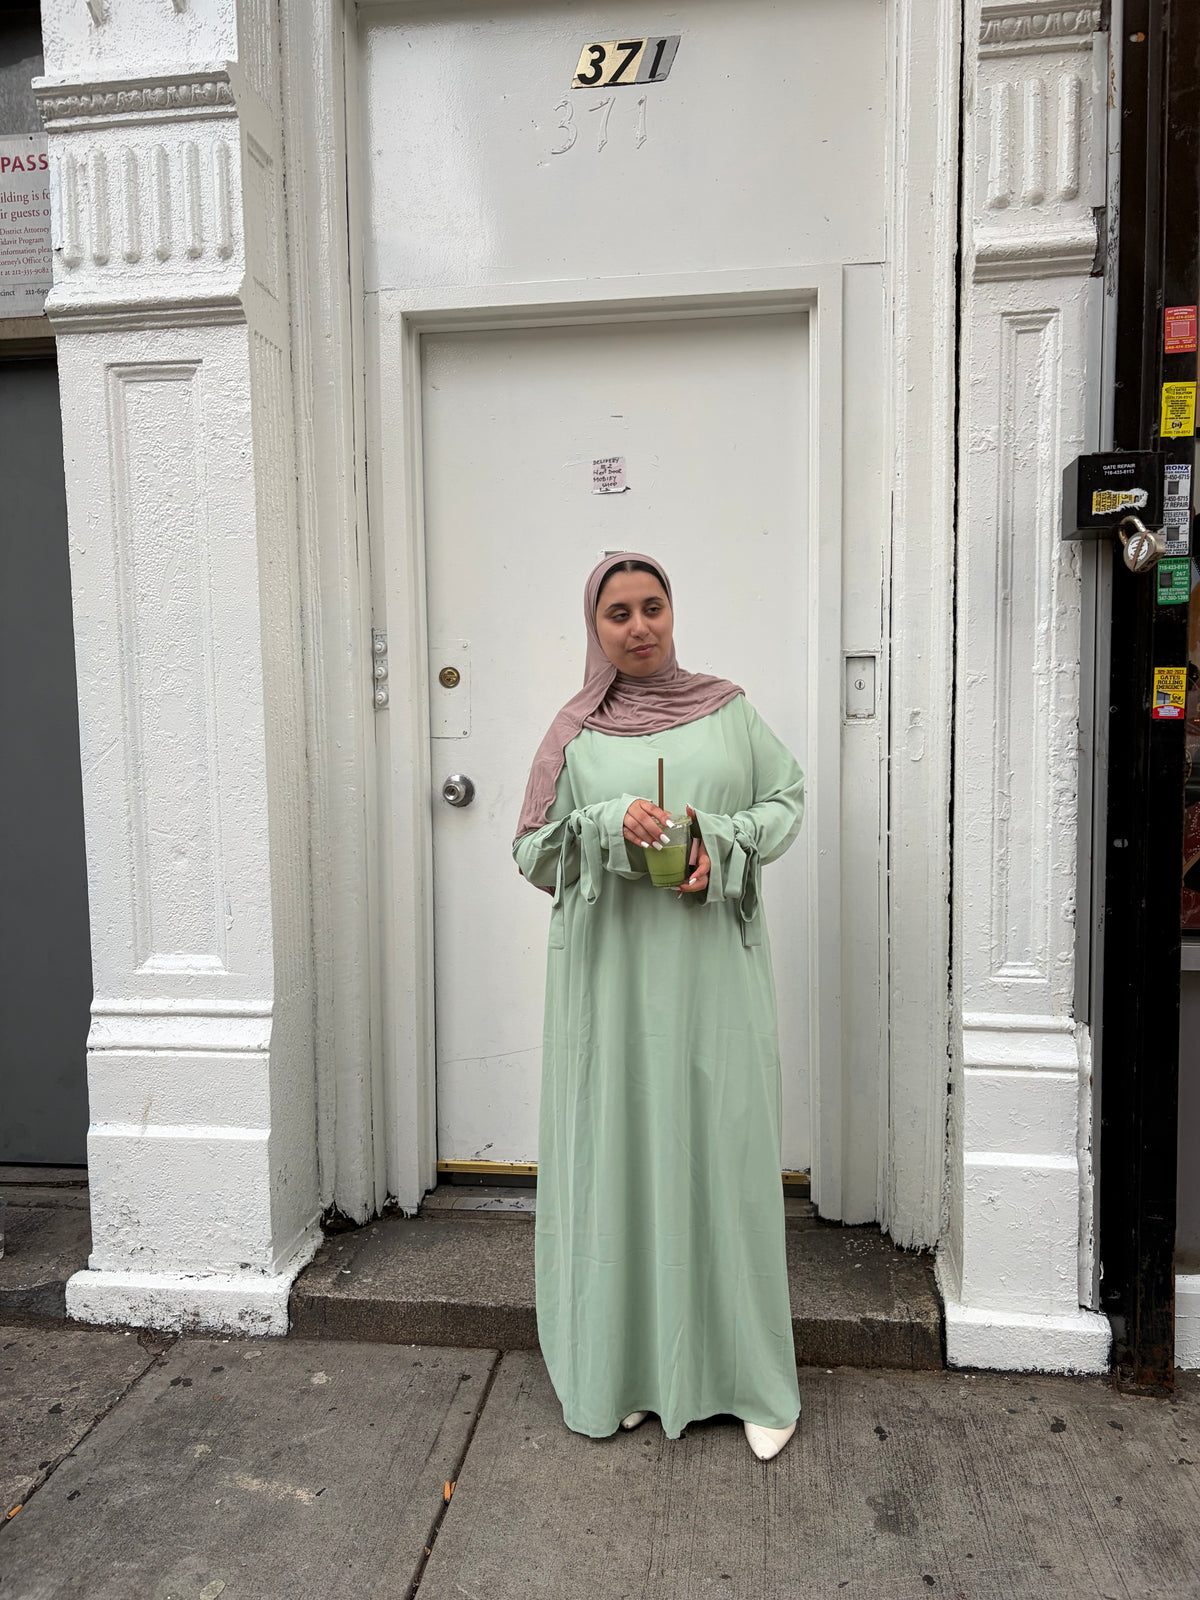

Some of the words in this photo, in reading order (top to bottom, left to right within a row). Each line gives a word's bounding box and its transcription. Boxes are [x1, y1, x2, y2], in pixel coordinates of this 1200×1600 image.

[577, 39, 667, 85] 371
[551, 95, 647, 155] 371
[1, 153, 49, 173] PASS
[0, 191, 29, 205] ilding
[32, 190, 40, 201] is
[10, 209, 40, 222] guests
[18, 236, 44, 246] Program
[0, 247, 37, 256] information
[22, 256, 41, 265] Office
